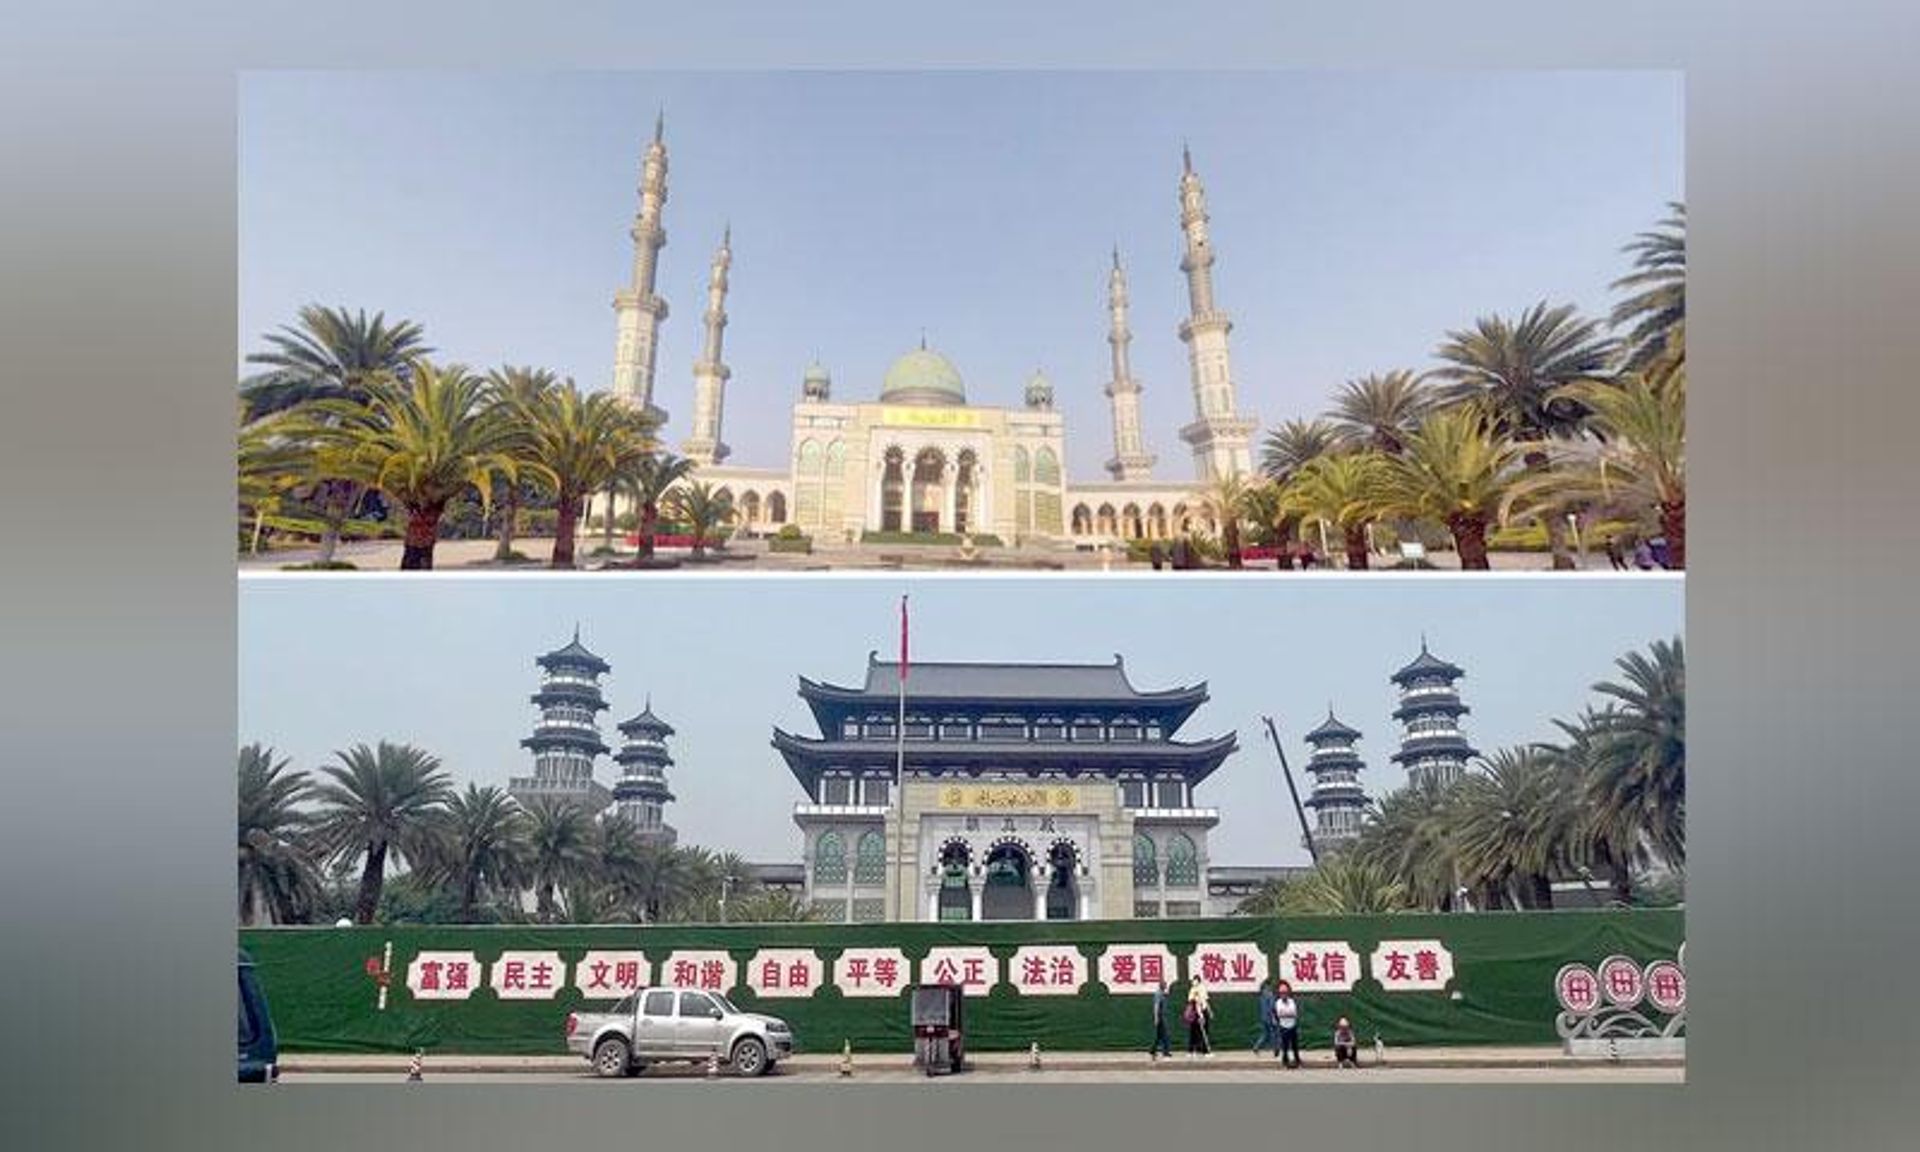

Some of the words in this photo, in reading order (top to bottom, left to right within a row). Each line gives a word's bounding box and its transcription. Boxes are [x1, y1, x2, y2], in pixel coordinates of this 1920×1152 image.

[420, 960, 469, 990] 富强
[503, 960, 553, 989] 民主
[589, 960, 638, 988] 文明
[674, 960, 725, 988] 和谐
[761, 960, 809, 988] 自由
[847, 957, 898, 987] 平等
[934, 957, 986, 985] 公正
[1022, 956, 1075, 985] 法治
[1112, 954, 1164, 984] 爱国
[1202, 954, 1256, 983] 敬业
[1292, 953, 1346, 982] 诚信
[1385, 951, 1441, 981] 友善
